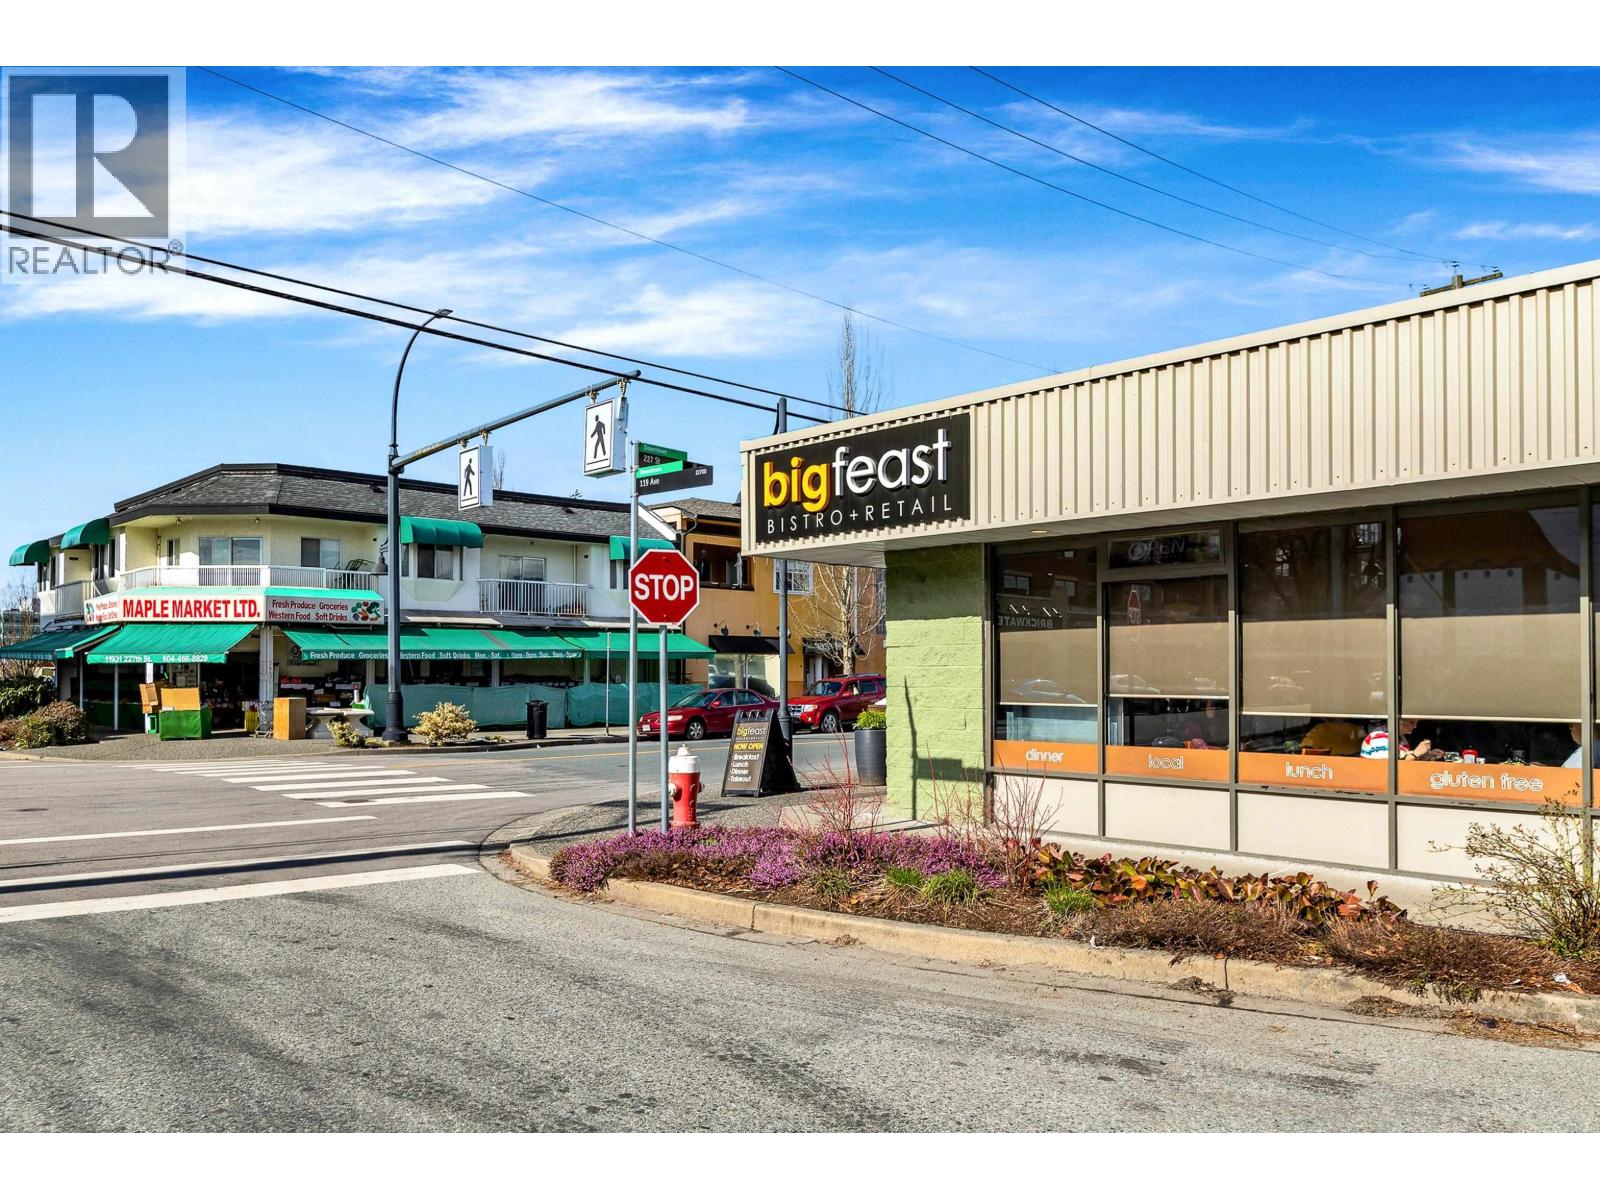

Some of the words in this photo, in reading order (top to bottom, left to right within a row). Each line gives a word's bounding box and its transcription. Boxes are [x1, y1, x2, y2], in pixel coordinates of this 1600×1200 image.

[643, 455, 654, 464] 227
[655, 456, 661, 464] St
[639, 479, 649, 487] 119
[650, 477, 660, 486] Ave
[1128, 536, 1185, 561] OPEN
[634, 573, 694, 601] STOP
[123, 599, 169, 618] MAPLE
[172, 599, 231, 618] MARKET
[233, 599, 261, 618] LTD.
[272, 600, 290, 609] Fresh
[290, 601, 316, 609] Produce
[319, 602, 348, 611] Groceries
[268, 610, 295, 619] Western
[295, 612, 311, 620] Food
[315, 612, 328, 620] Soft
[329, 613, 348, 621] Drinks
[310, 651, 328, 659] Fresh
[329, 651, 355, 659] Produce
[358, 651, 389, 659] Groceries
[733, 742, 747, 750] NOW
[748, 742, 764, 750] OPEN
[1025, 747, 1064, 763] dinner
[1148, 754, 1184, 769] local
[1285, 761, 1334, 780] lunch
[1429, 769, 1495, 790] gluten
[1500, 772, 1544, 792] free
